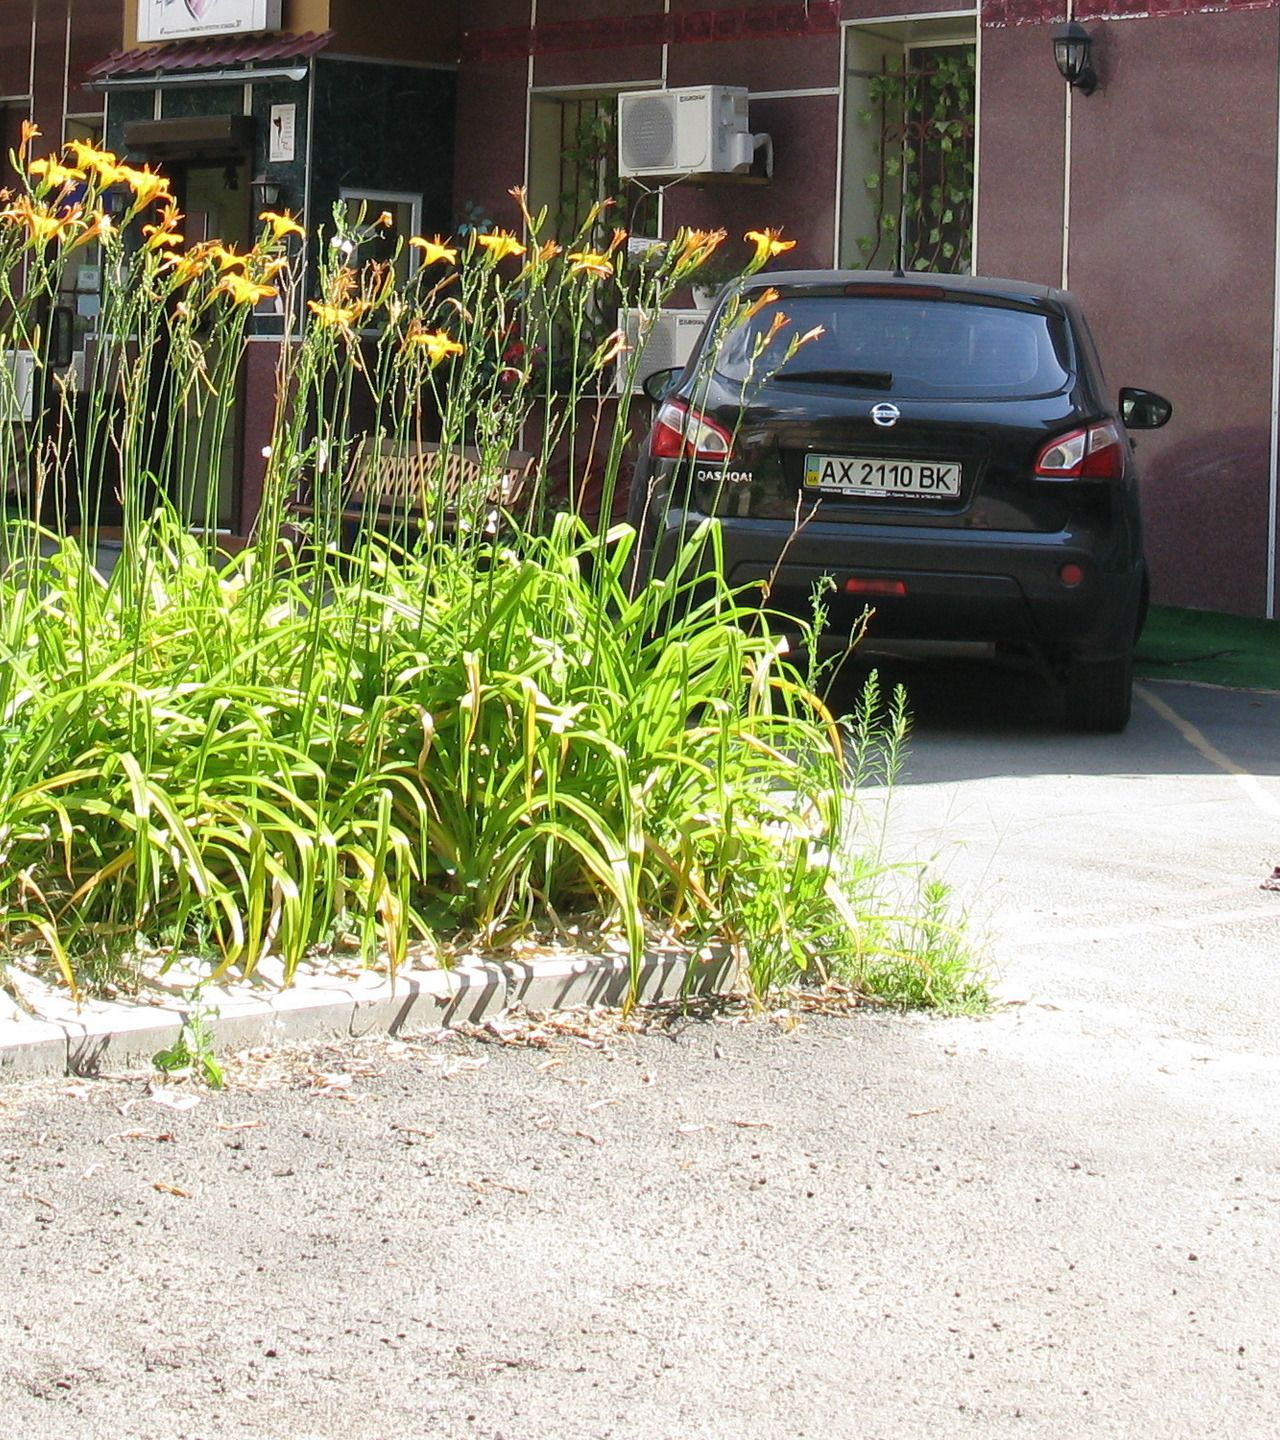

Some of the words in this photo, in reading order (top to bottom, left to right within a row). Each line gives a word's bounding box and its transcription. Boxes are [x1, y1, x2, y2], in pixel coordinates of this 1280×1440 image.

[697, 470, 753, 482] QASHQAI
[821, 461, 853, 484] AX
[860, 463, 913, 488] 2110
[919, 467, 952, 491] BK
